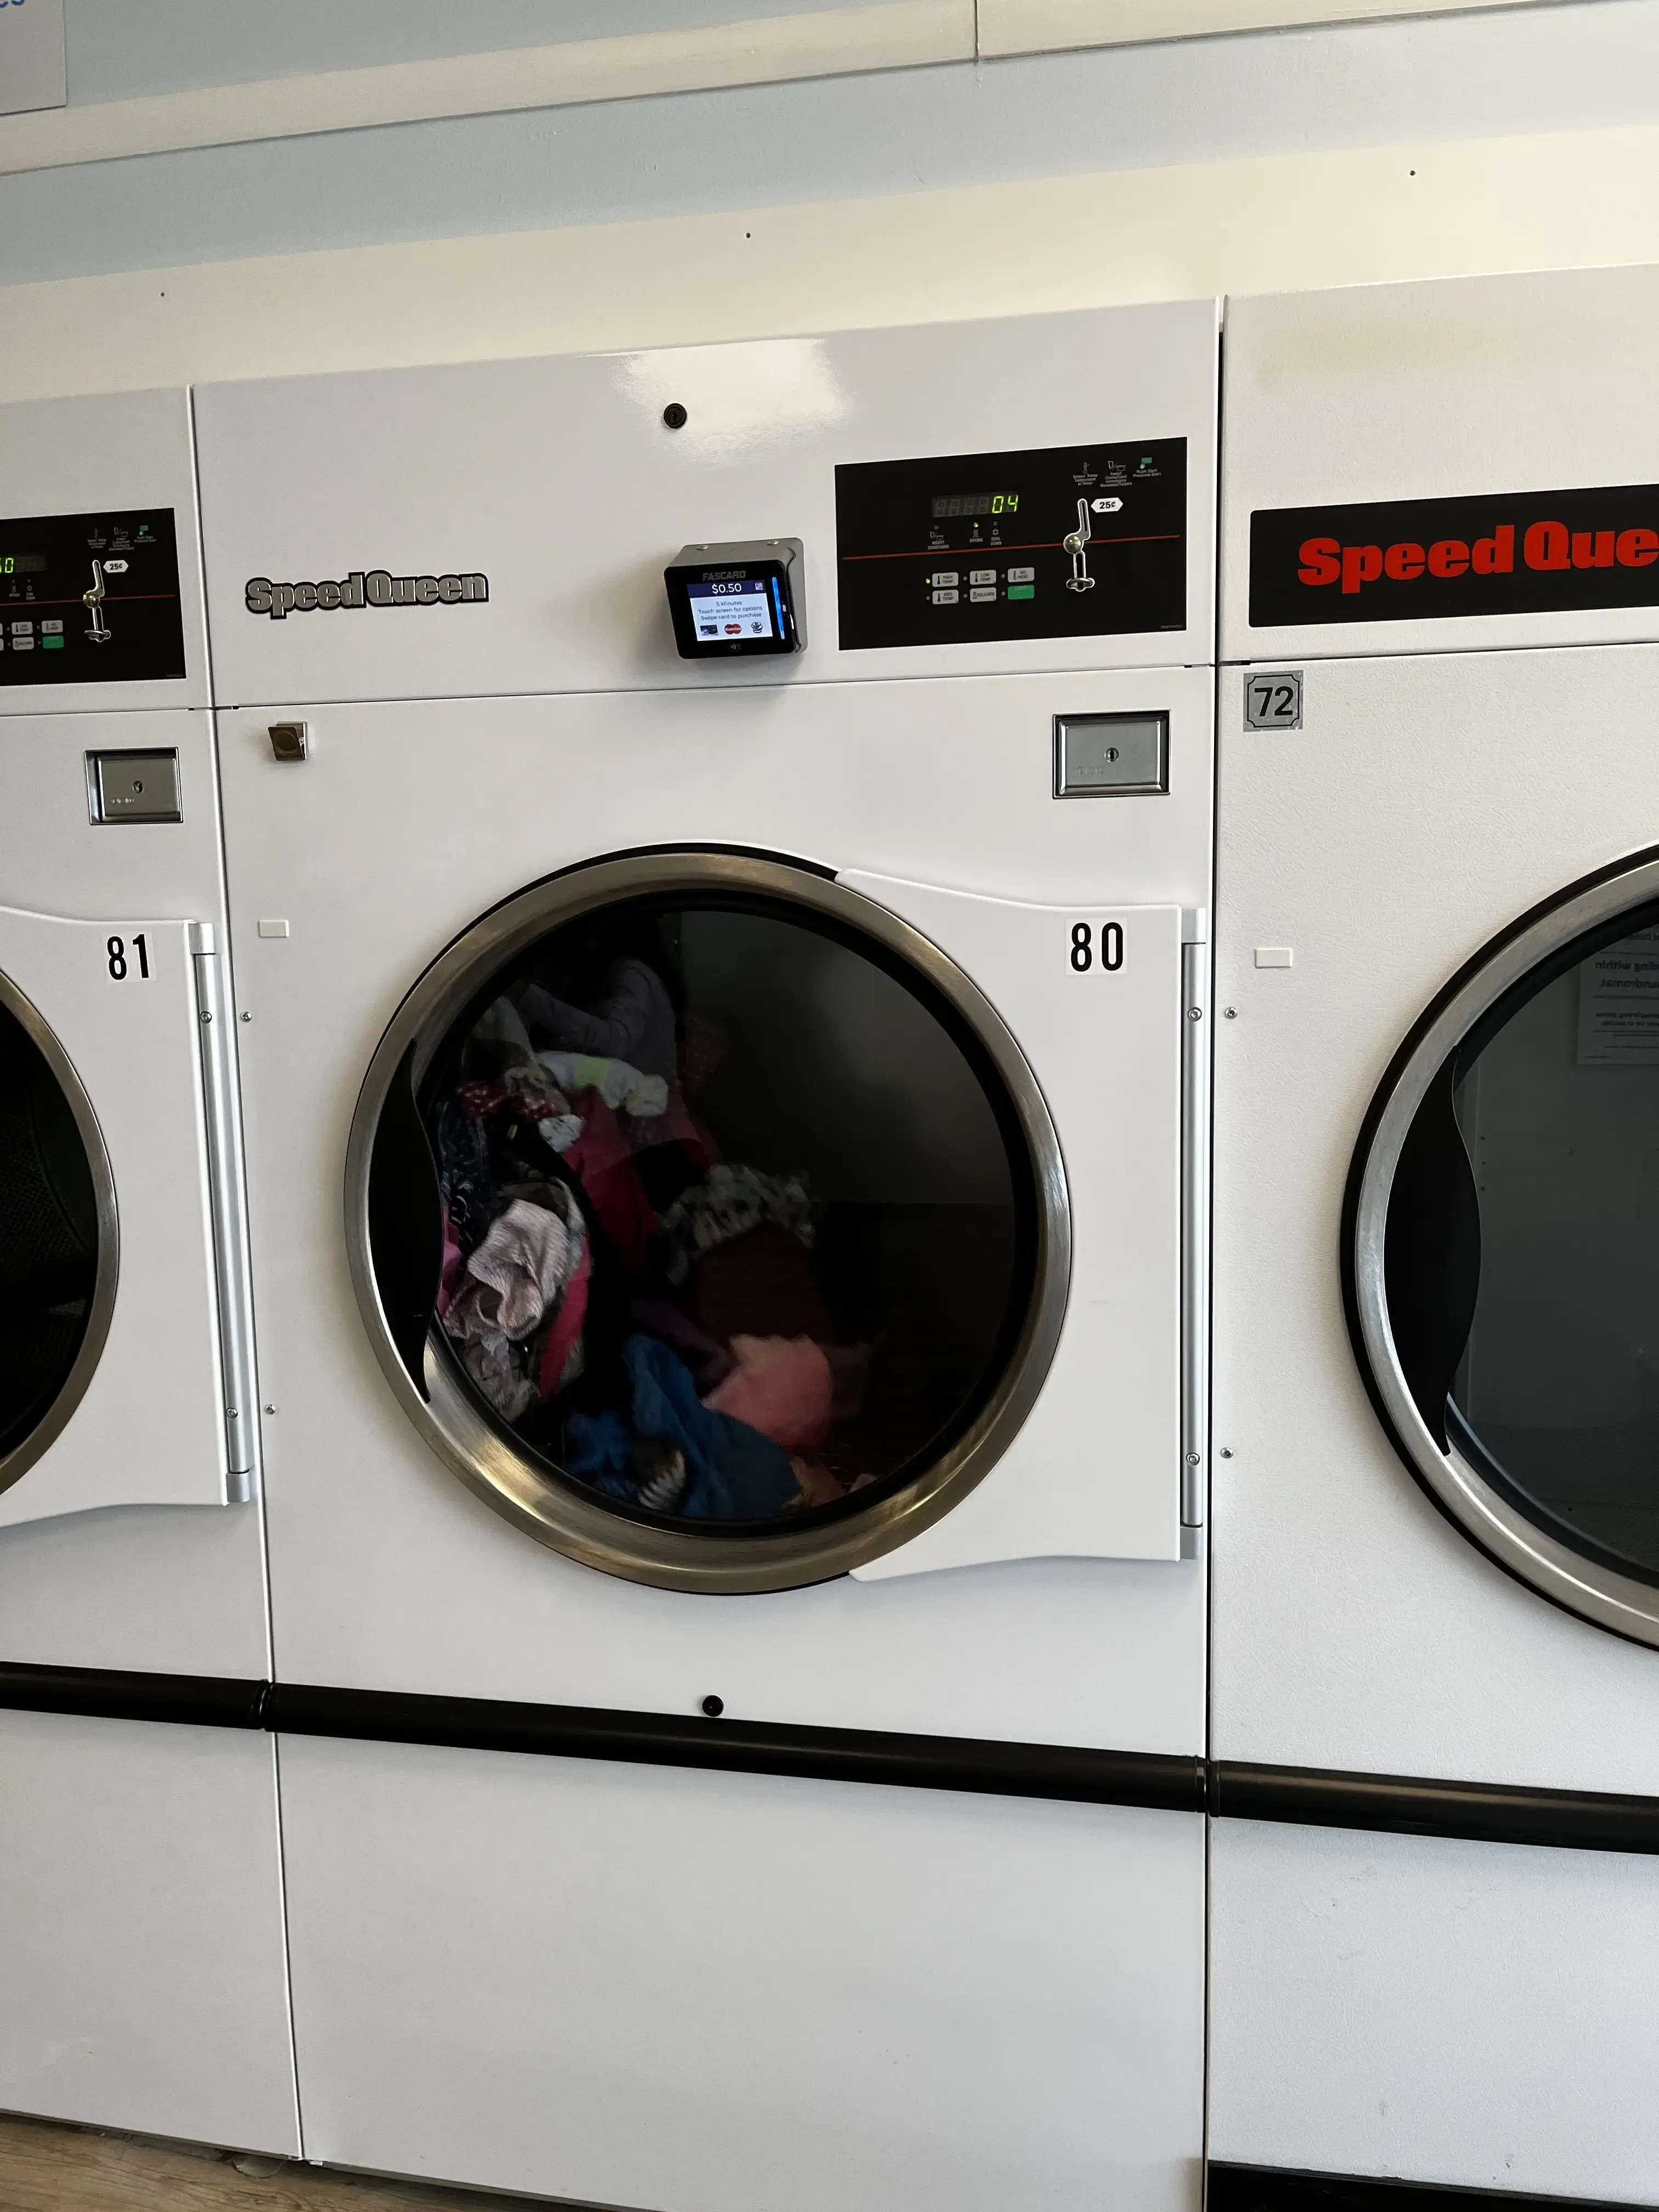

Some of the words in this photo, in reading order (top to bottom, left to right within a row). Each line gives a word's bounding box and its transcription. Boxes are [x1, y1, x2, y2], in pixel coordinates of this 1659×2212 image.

[992, 494, 1018, 514] 04
[1099, 501, 1116, 510] 25¢
[1298, 525, 1514, 594] Speed
[702, 570, 746, 581] FASCARD
[712, 583, 742, 595] $0.50
[1254, 686, 1294, 718] 72
[107, 934, 149, 980] 81
[1071, 922, 1124, 972] 80
